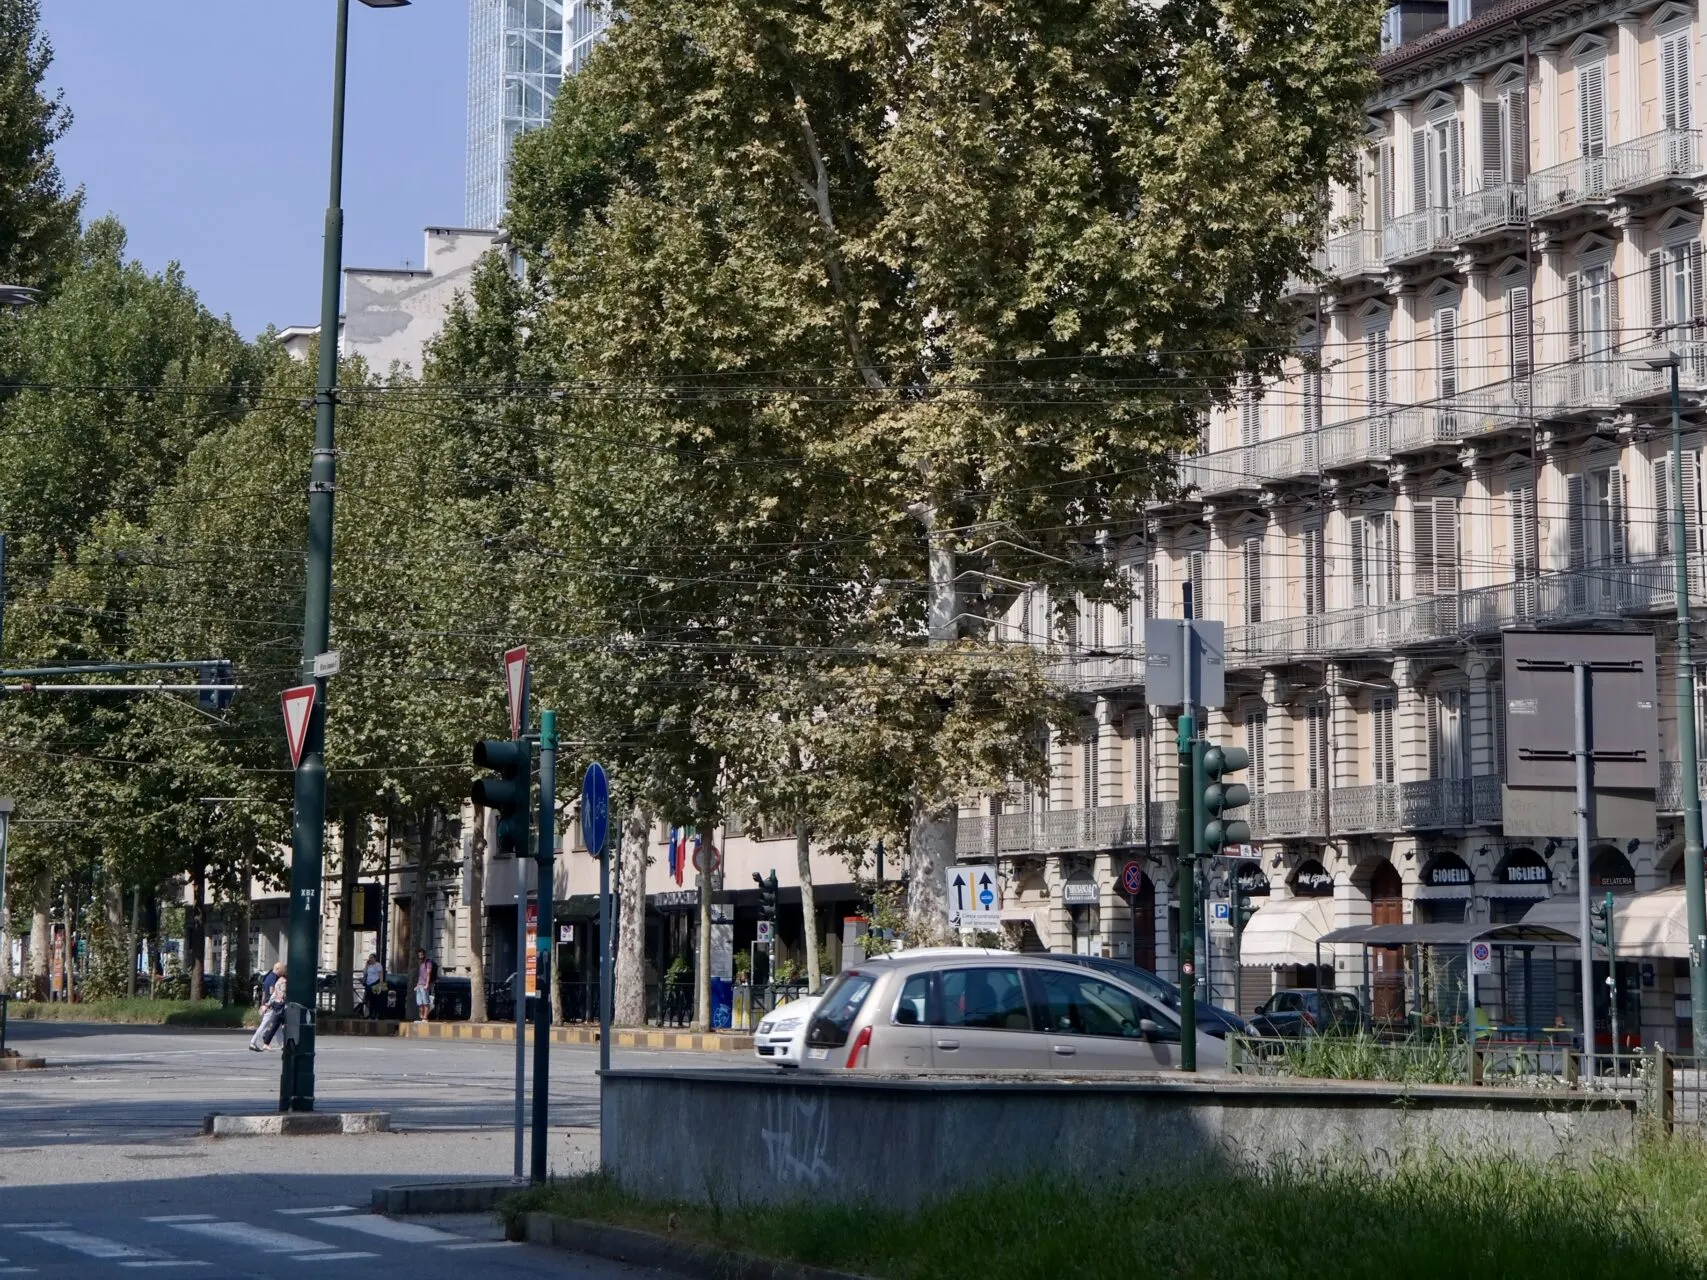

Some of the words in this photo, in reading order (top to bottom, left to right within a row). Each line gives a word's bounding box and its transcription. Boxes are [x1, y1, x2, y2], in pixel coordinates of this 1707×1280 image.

[1432, 868, 1470, 883] GIOIELLI
[1507, 865, 1547, 881] TIGLIERI
[1601, 877, 1633, 886] GELATERIA
[1217, 905, 1226, 917] P
